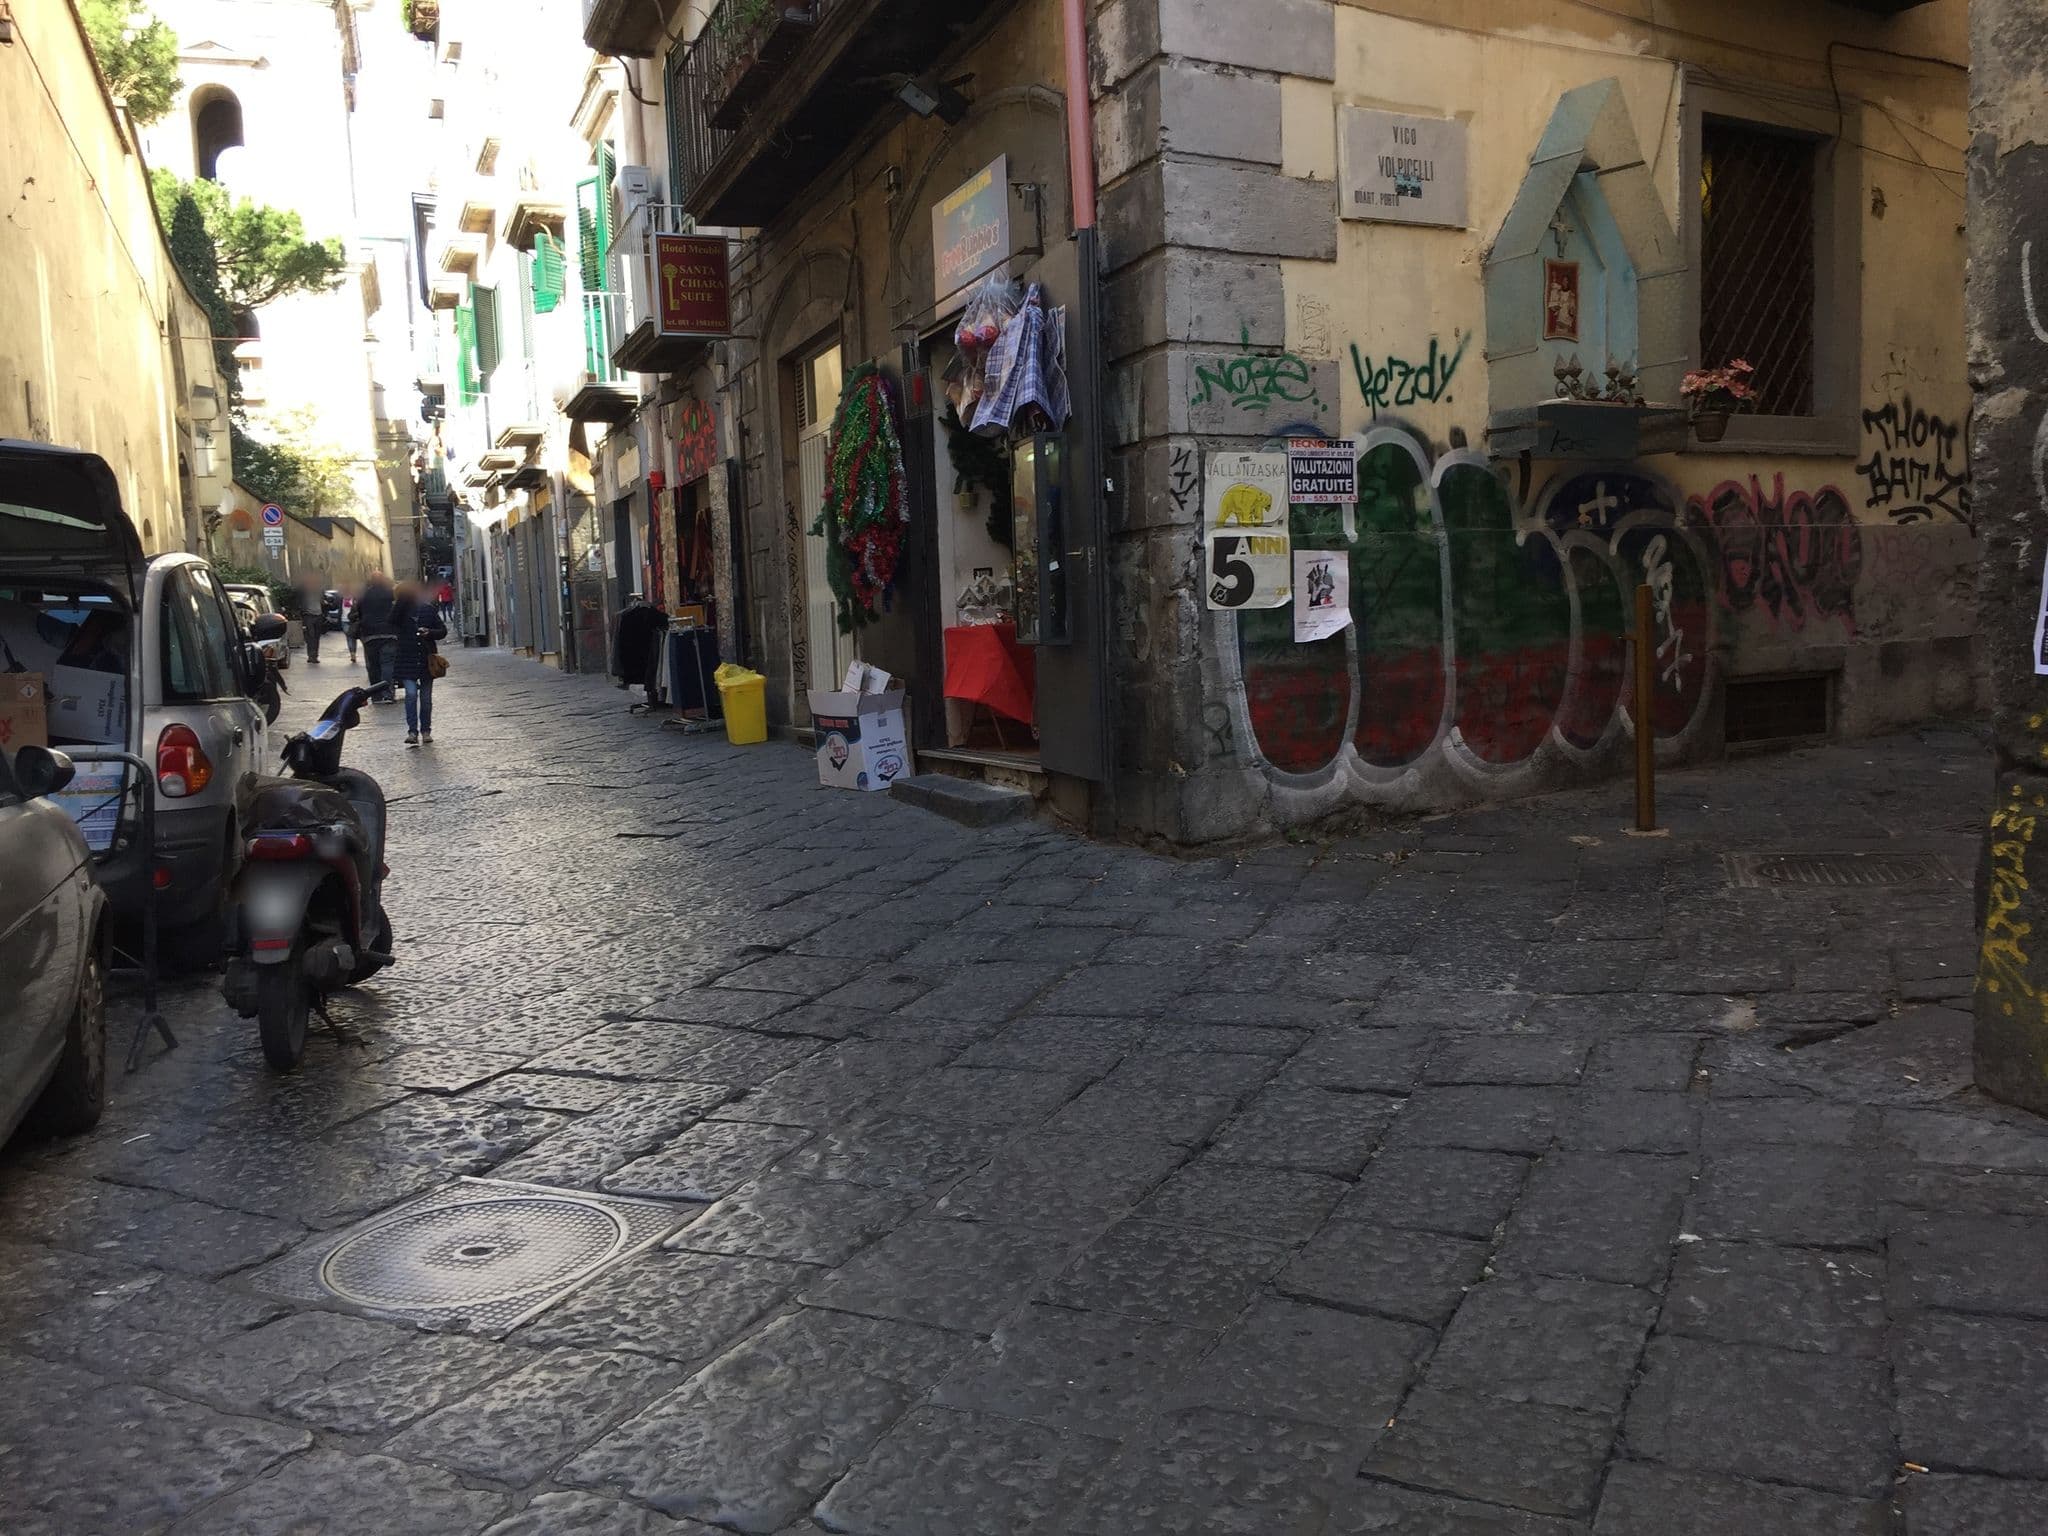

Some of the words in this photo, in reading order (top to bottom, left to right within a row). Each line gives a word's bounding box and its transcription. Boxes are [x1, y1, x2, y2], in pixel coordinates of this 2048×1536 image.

[1393, 126, 1417, 146] VICO
[1378, 155, 1434, 182] VOLPICELLI
[662, 243, 686, 253] Hotel
[679, 264, 716, 276] SANTA
[680, 278, 724, 289] CHIARA
[680, 291, 713, 302] SUITE
[1290, 440, 1356, 449] TECNORETE
[1207, 463, 1286, 478] VALLANZASKA
[1293, 459, 1352, 475] VALUTAZIONI
[1293, 478, 1353, 492] GRATUITE
[1209, 537, 1254, 607] 5
[1234, 536, 1288, 555] ANNI
